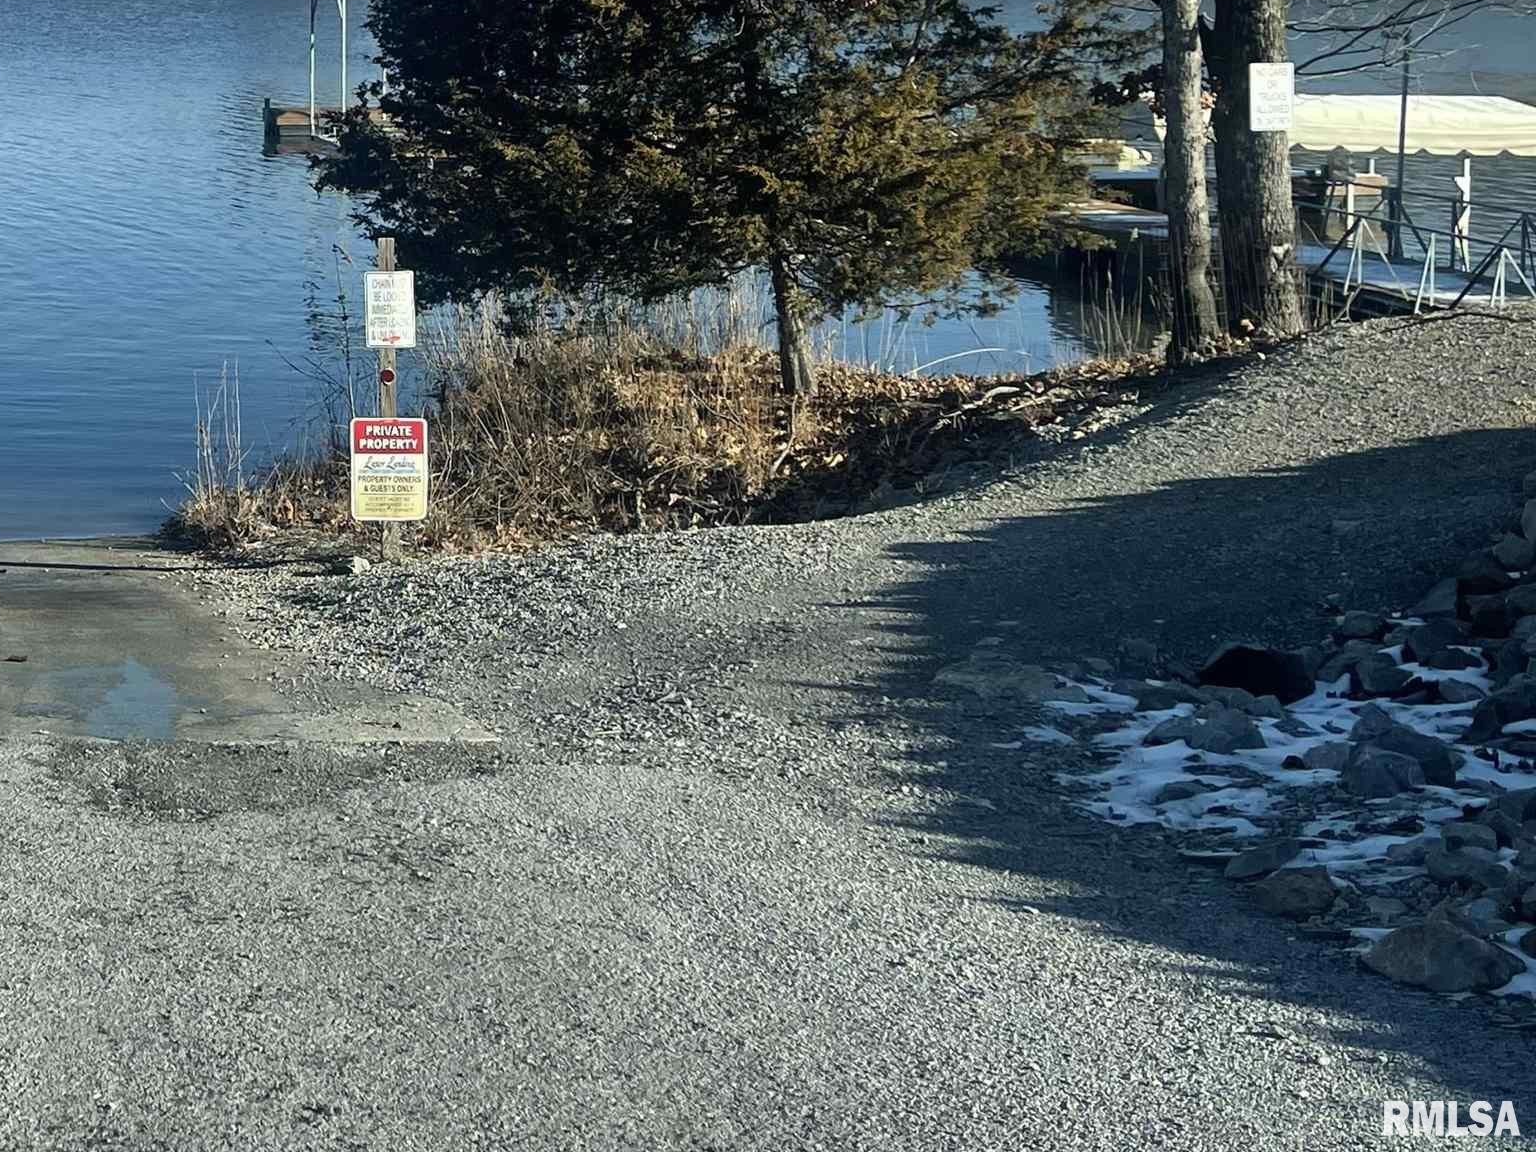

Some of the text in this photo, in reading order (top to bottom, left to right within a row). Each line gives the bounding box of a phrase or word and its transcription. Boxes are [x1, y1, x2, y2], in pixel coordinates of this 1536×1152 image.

[373, 290, 382, 302] BE
[366, 425, 413, 436] PRIVATE
[359, 438, 419, 450] PROPERTY
[358, 474, 422, 484] PROPERTY OWNERS
[370, 484, 396, 493] GUESTS
[396, 484, 414, 493] ONLY
